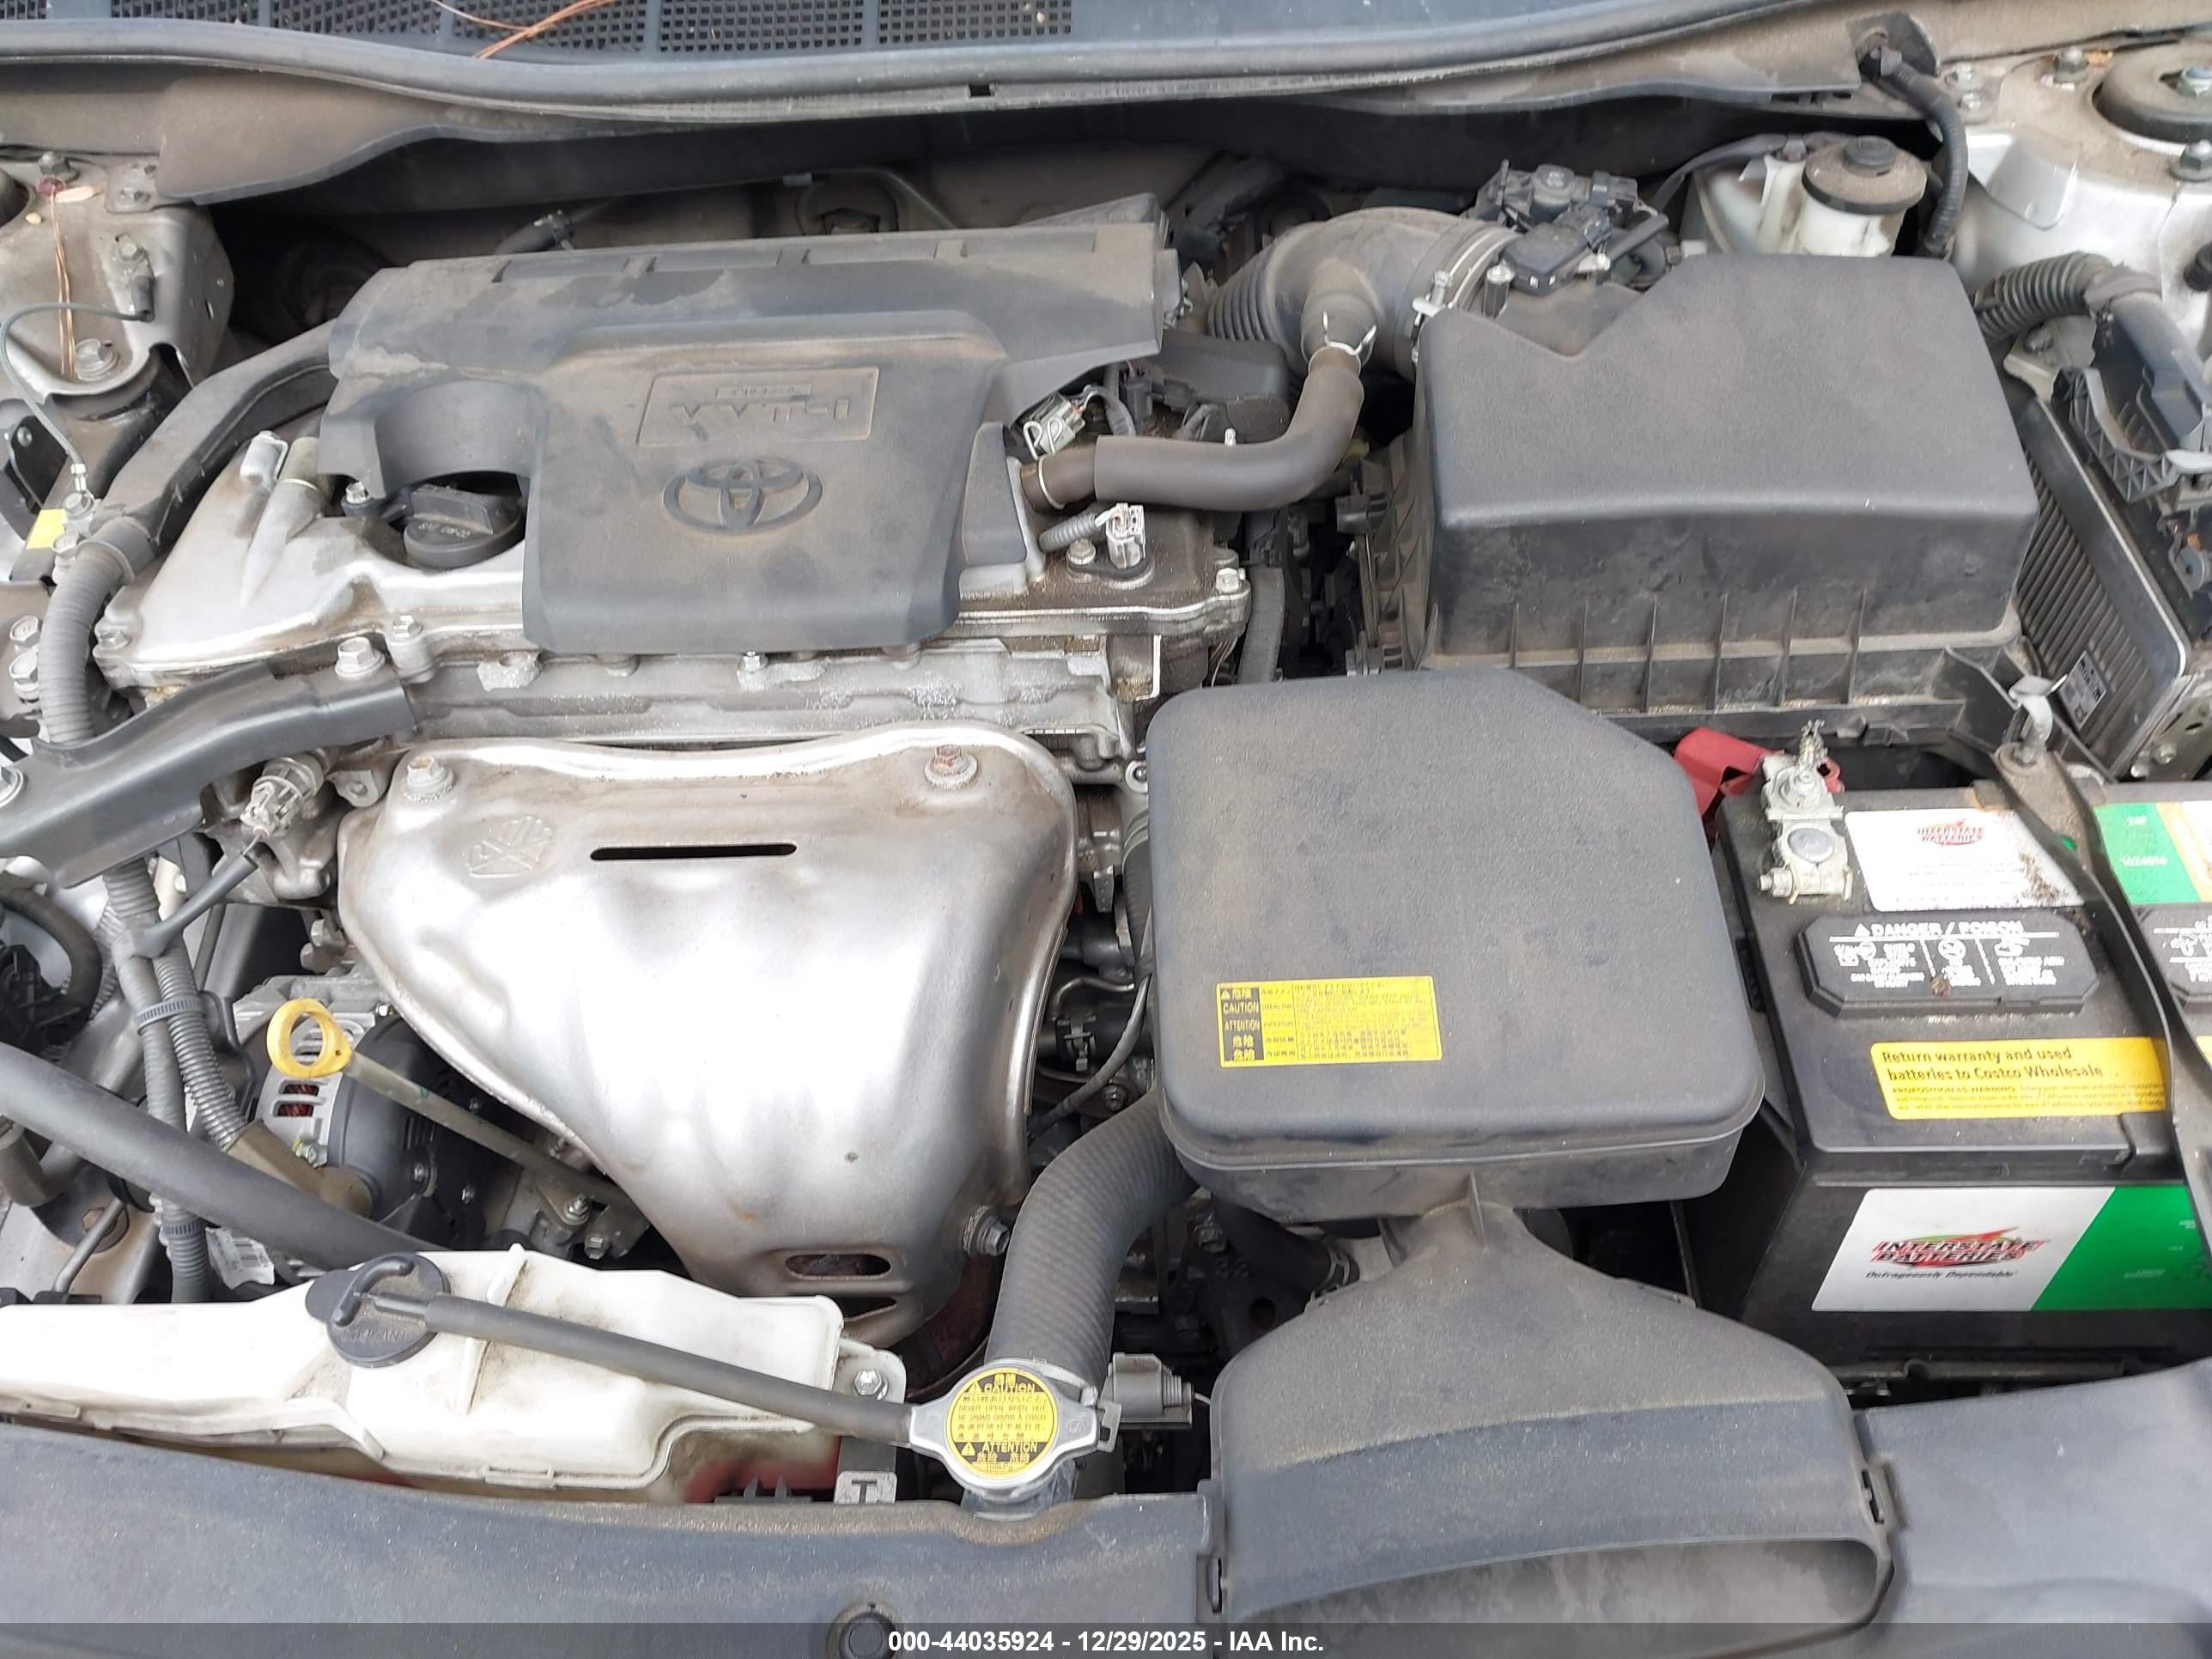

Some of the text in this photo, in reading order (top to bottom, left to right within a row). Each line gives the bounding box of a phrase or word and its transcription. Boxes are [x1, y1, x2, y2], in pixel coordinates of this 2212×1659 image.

[1871, 922, 1942, 937] DANGER
[1959, 921, 2024, 935] POISON
[1223, 1001, 1259, 1015] CAUTION
[1224, 1019, 1260, 1031] ATTENTION
[1882, 1046, 2072, 1064] Return warranty and used
[1887, 1063, 2103, 1080] batteries to Costco Wholesale
[1874, 1240, 2042, 1253] INTERSTATE
[1873, 1251, 2021, 1262] BATTERIES
[1865, 1270, 2014, 1279] Outrageously Dependable
[984, 1382, 1036, 1393] CAUTION
[981, 1442, 1038, 1453] ATTENTION
